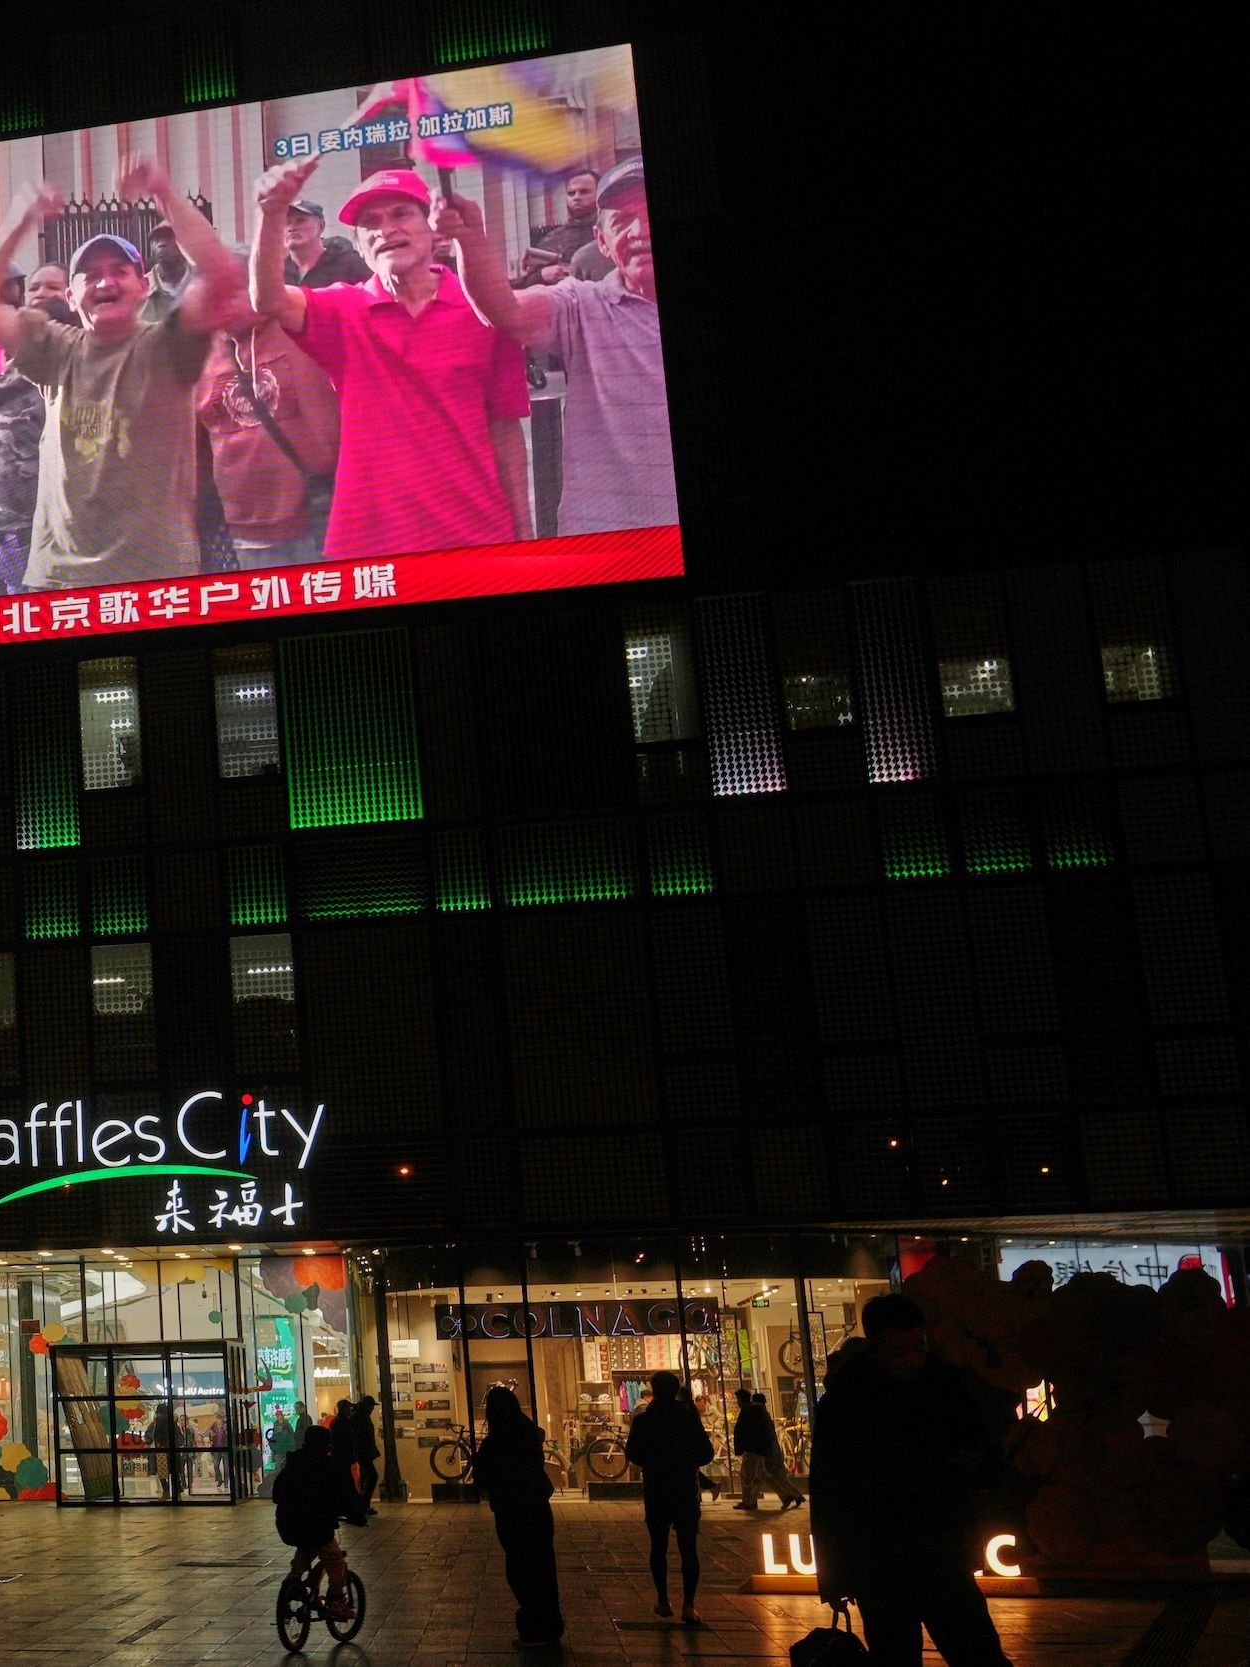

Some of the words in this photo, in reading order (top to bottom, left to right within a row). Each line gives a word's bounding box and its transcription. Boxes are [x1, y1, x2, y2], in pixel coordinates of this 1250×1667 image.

[276, 136, 310, 156] 3日
[320, 121, 410, 152] 委内瑞拉
[419, 104, 511, 136] 加拉加斯
[2, 563, 397, 634] 北京歌华户外传媒
[154, 1179, 304, 1234] 来福士
[481, 1302, 710, 1338] COLNAGO
